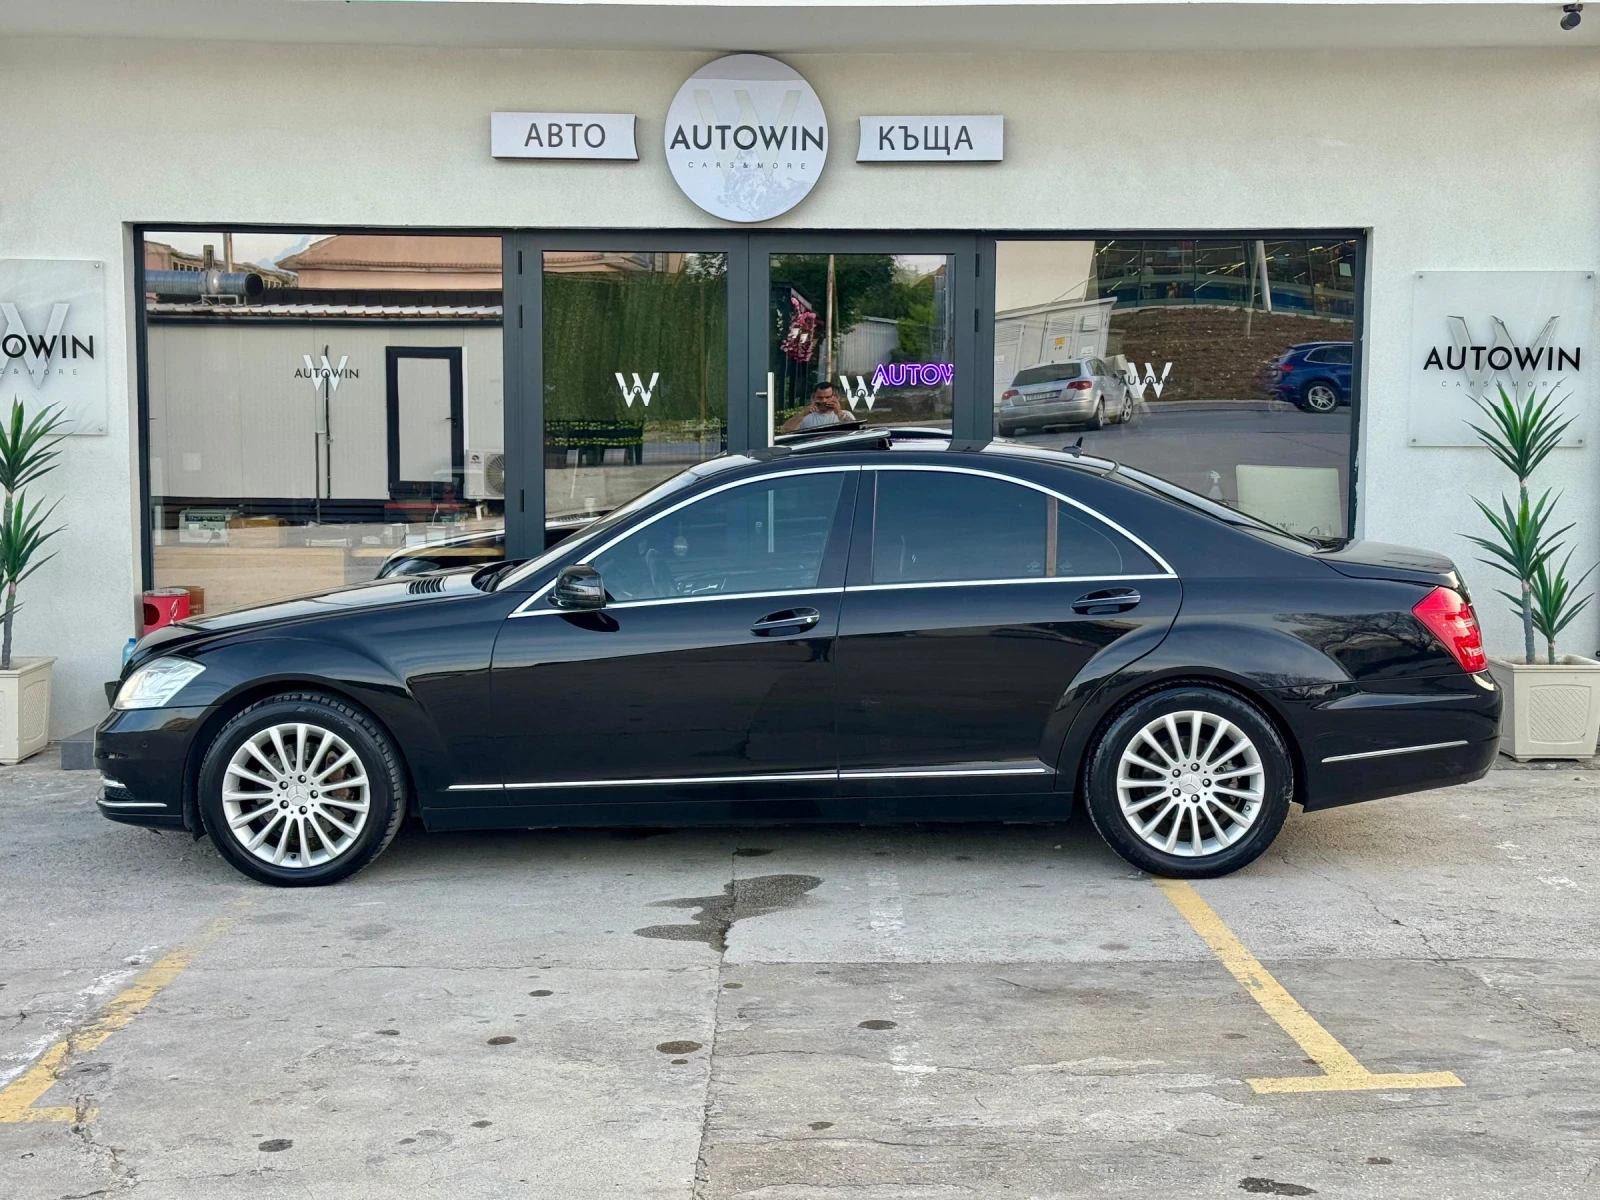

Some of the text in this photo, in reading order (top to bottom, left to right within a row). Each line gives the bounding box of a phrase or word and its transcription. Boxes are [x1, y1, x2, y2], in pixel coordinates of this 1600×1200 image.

[524, 122, 606, 148] АВТО
[669, 124, 824, 151] AUTOWIN
[878, 125, 974, 156] КЪЩА
[1422, 345, 1581, 372] AUTOWIN
[294, 367, 359, 379] AUTOWIN
